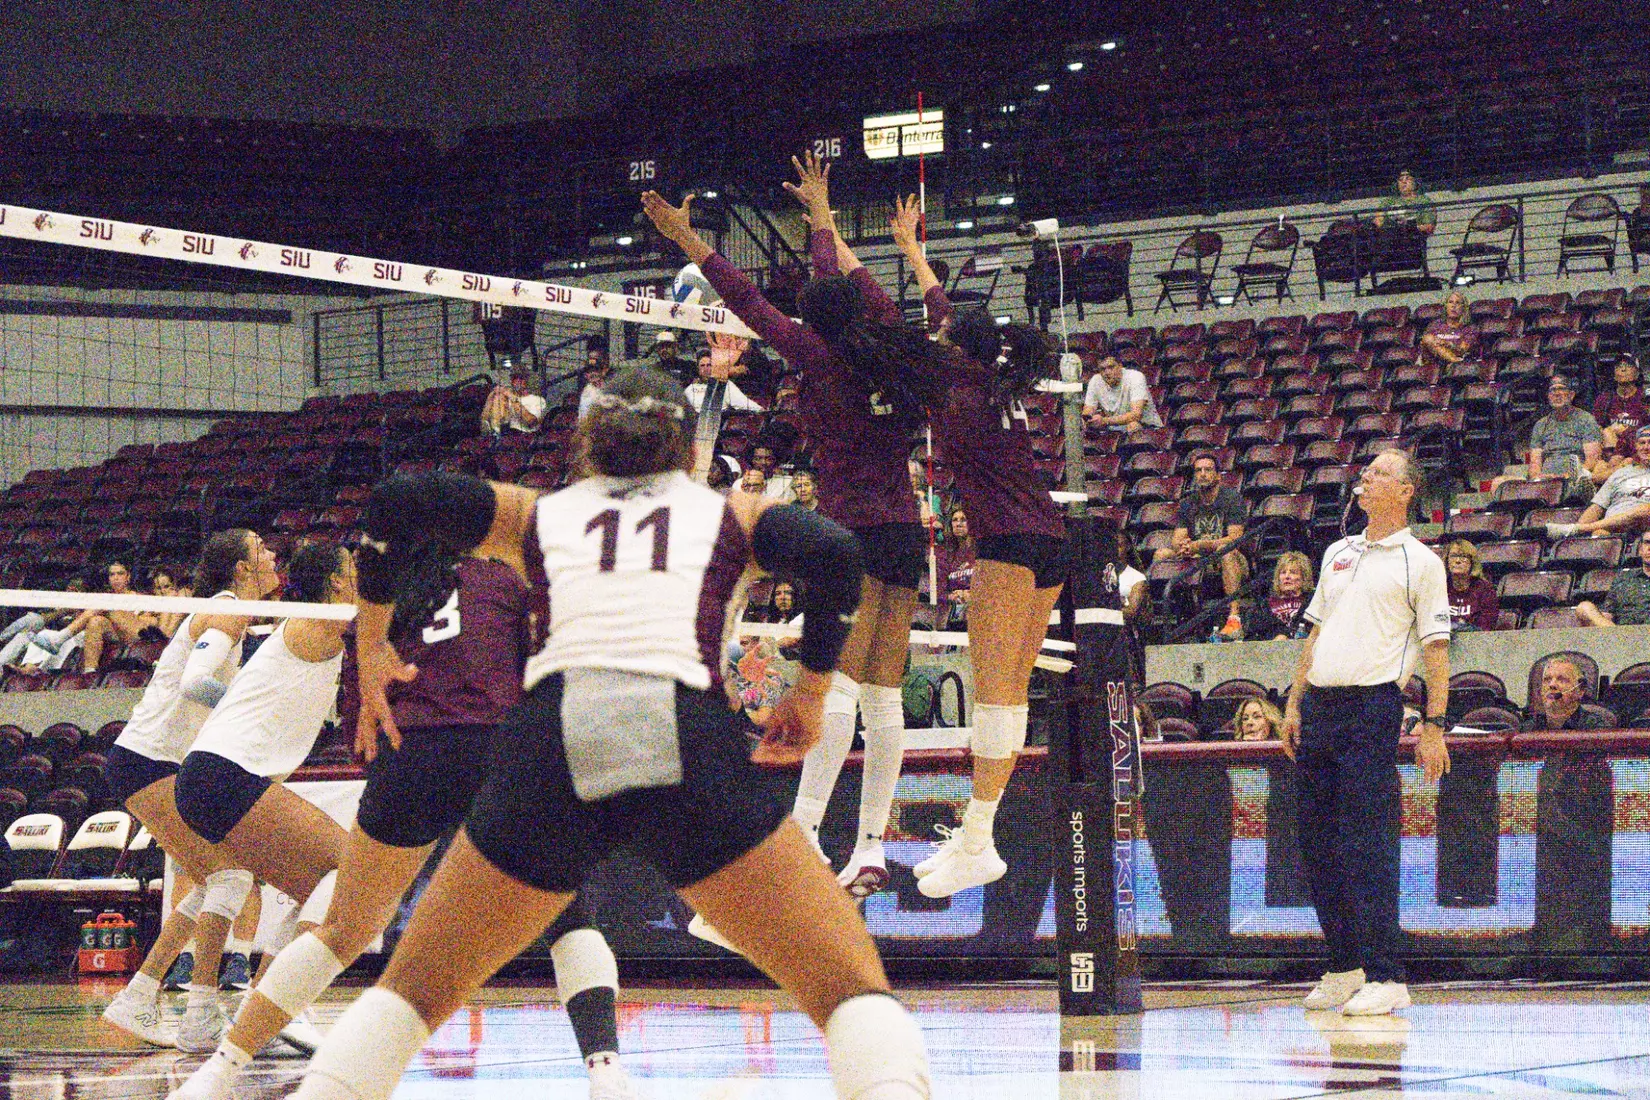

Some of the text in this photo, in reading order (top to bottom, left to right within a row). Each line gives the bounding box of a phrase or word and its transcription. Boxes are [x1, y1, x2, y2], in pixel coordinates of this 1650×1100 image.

[886, 130, 943, 144] Bnterra
[813, 138, 841, 158] 216
[629, 161, 655, 181] 215
[80, 219, 113, 241] SIU
[182, 235, 215, 255] SIU
[280, 249, 311, 269] SIU
[373, 262, 402, 282] SIU
[462, 274, 491, 292] SIU
[546, 286, 572, 304] SIU
[625, 297, 650, 315] SIU
[701, 307, 725, 324] SIU
[584, 506, 671, 572] 11
[1107, 681, 1136, 951] SALUKIS
[1069, 811, 1088, 932] sports imports
[93, 953, 105, 969] G
